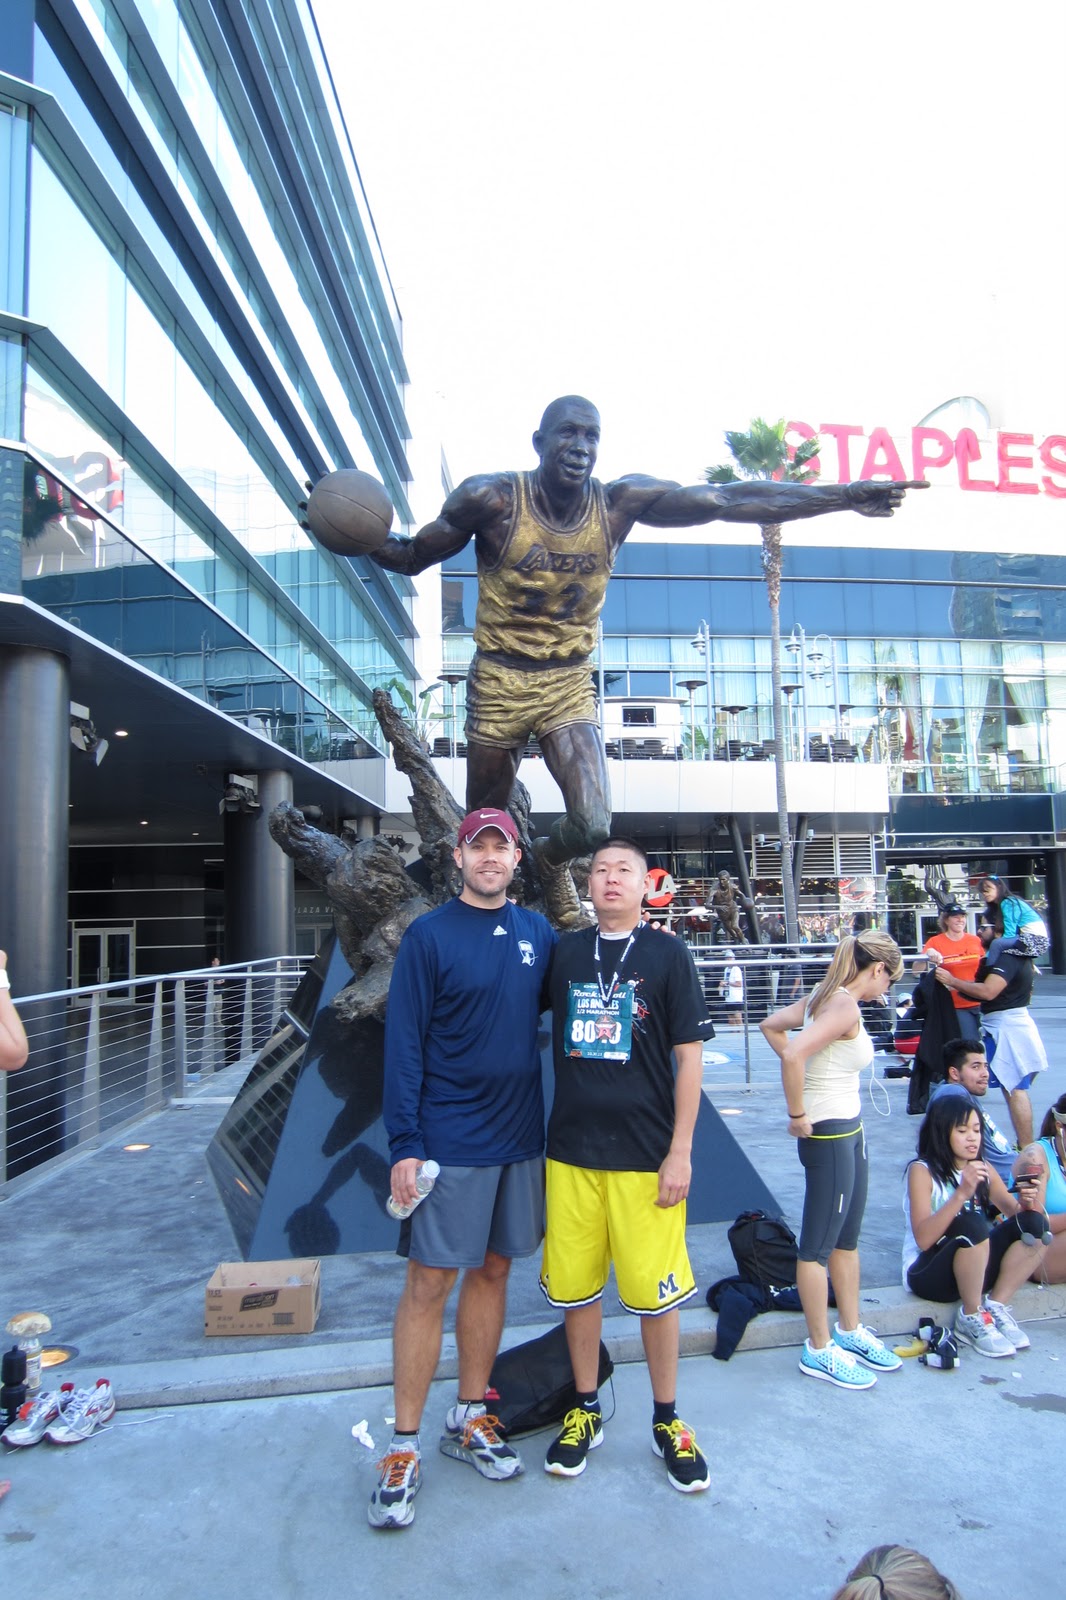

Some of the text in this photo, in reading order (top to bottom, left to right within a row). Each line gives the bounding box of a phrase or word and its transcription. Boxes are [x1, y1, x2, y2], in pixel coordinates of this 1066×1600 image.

[773, 421, 1066, 499] STAPLES
[511, 543, 598, 574] LAKERS
[648, 874, 677, 899] LA
[577, 999, 589, 1009] LOS
[658, 1272, 679, 1300] M
